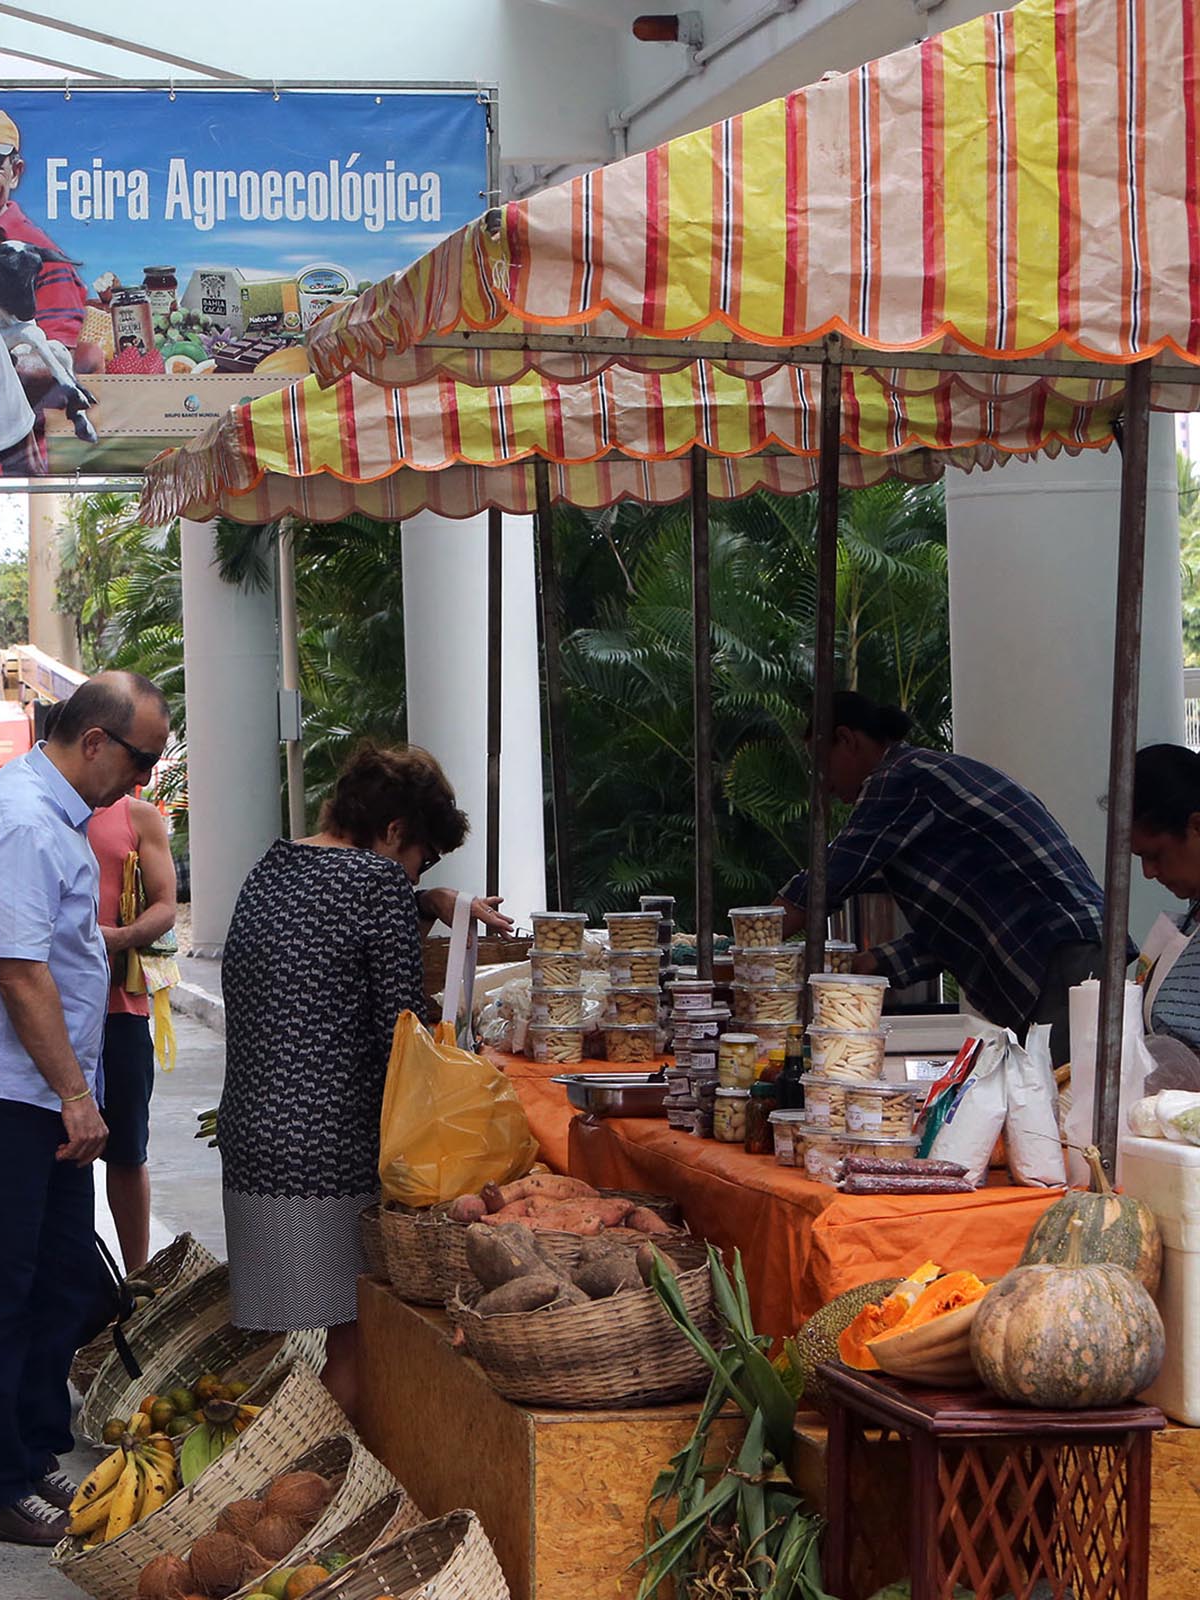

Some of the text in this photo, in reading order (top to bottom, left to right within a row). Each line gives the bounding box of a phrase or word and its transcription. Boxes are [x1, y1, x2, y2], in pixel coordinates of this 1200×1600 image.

[46, 152, 441, 232] Feira Agroecológica
[203, 299, 225, 307] BAHIA
